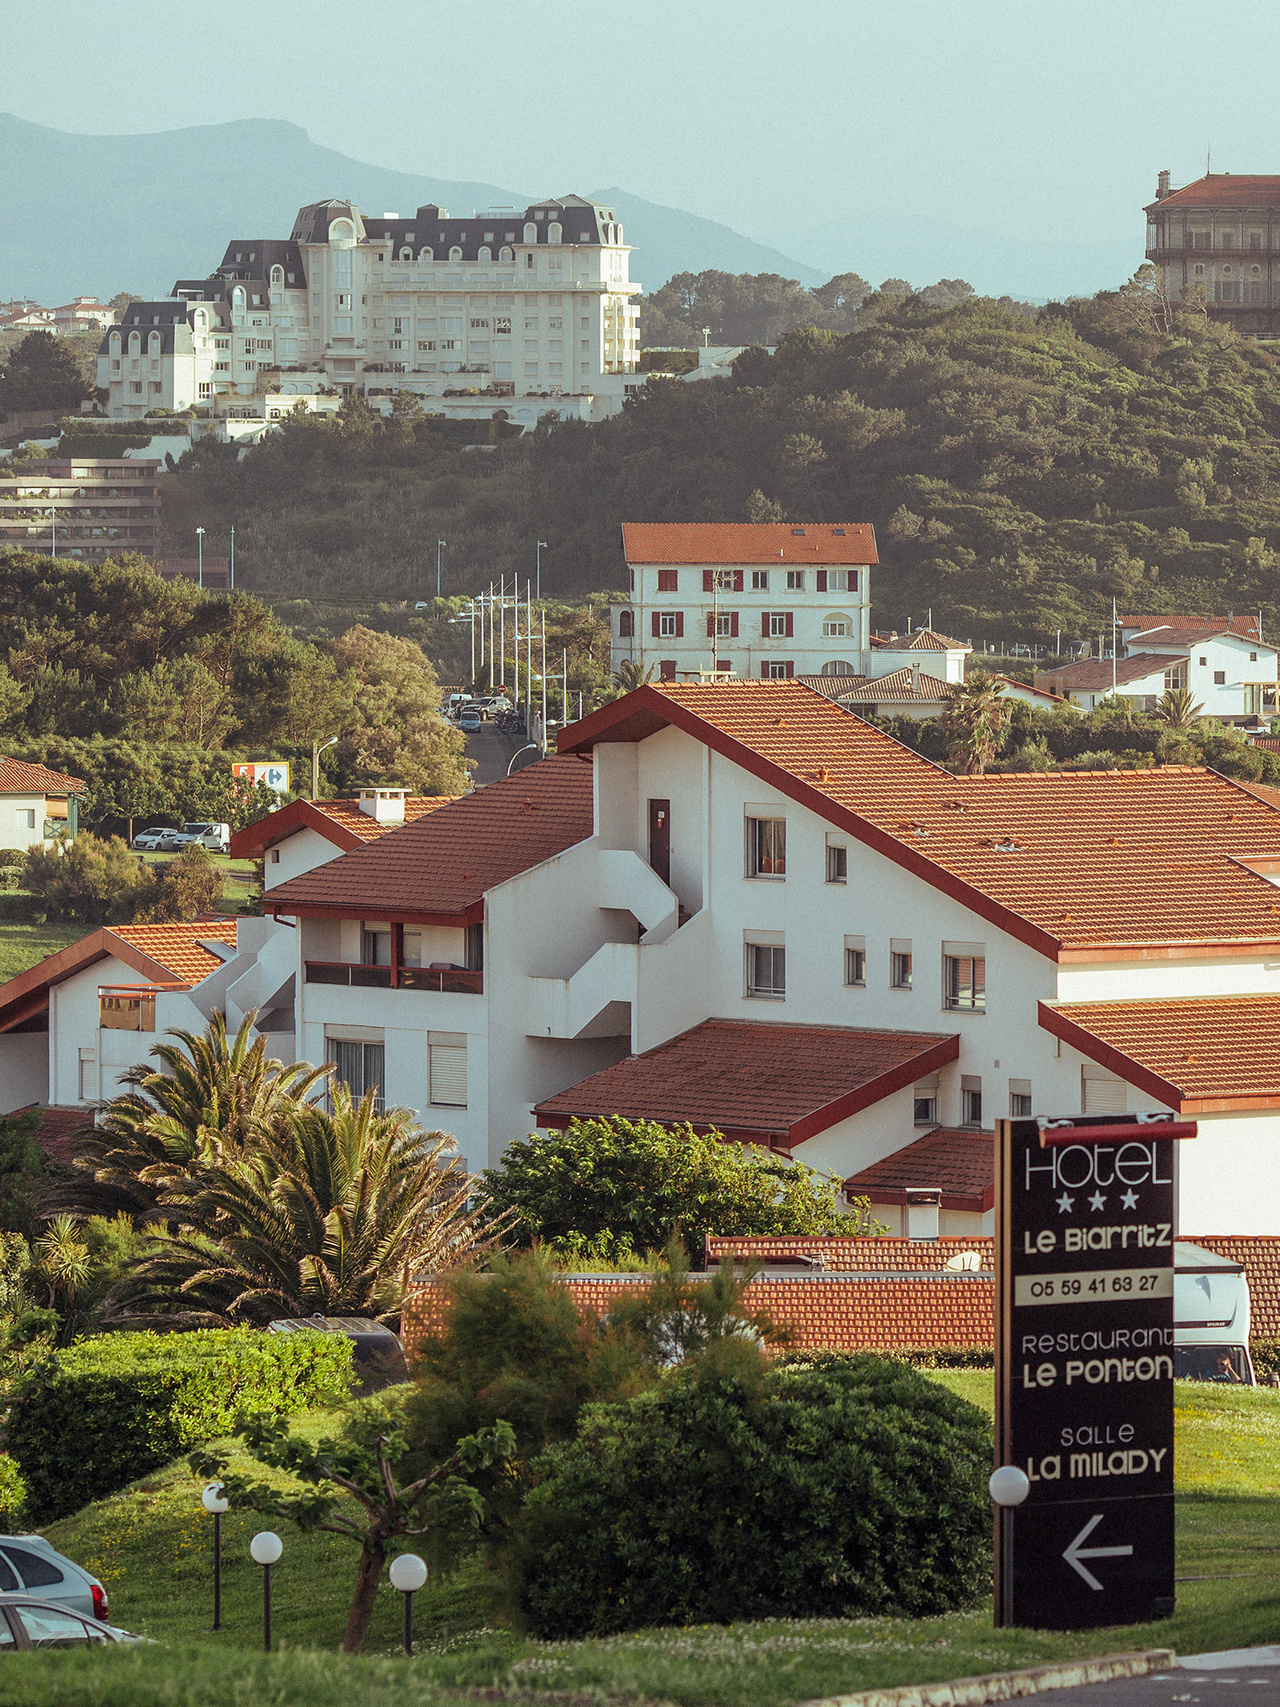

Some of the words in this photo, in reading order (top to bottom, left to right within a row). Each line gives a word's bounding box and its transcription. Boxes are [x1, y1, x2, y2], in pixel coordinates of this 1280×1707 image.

[1061, 1279, 1081, 1295] 59
[1088, 1278, 1105, 1294] 41
[1112, 1276, 1132, 1292] 63
[1139, 1275, 1159, 1291] 27
